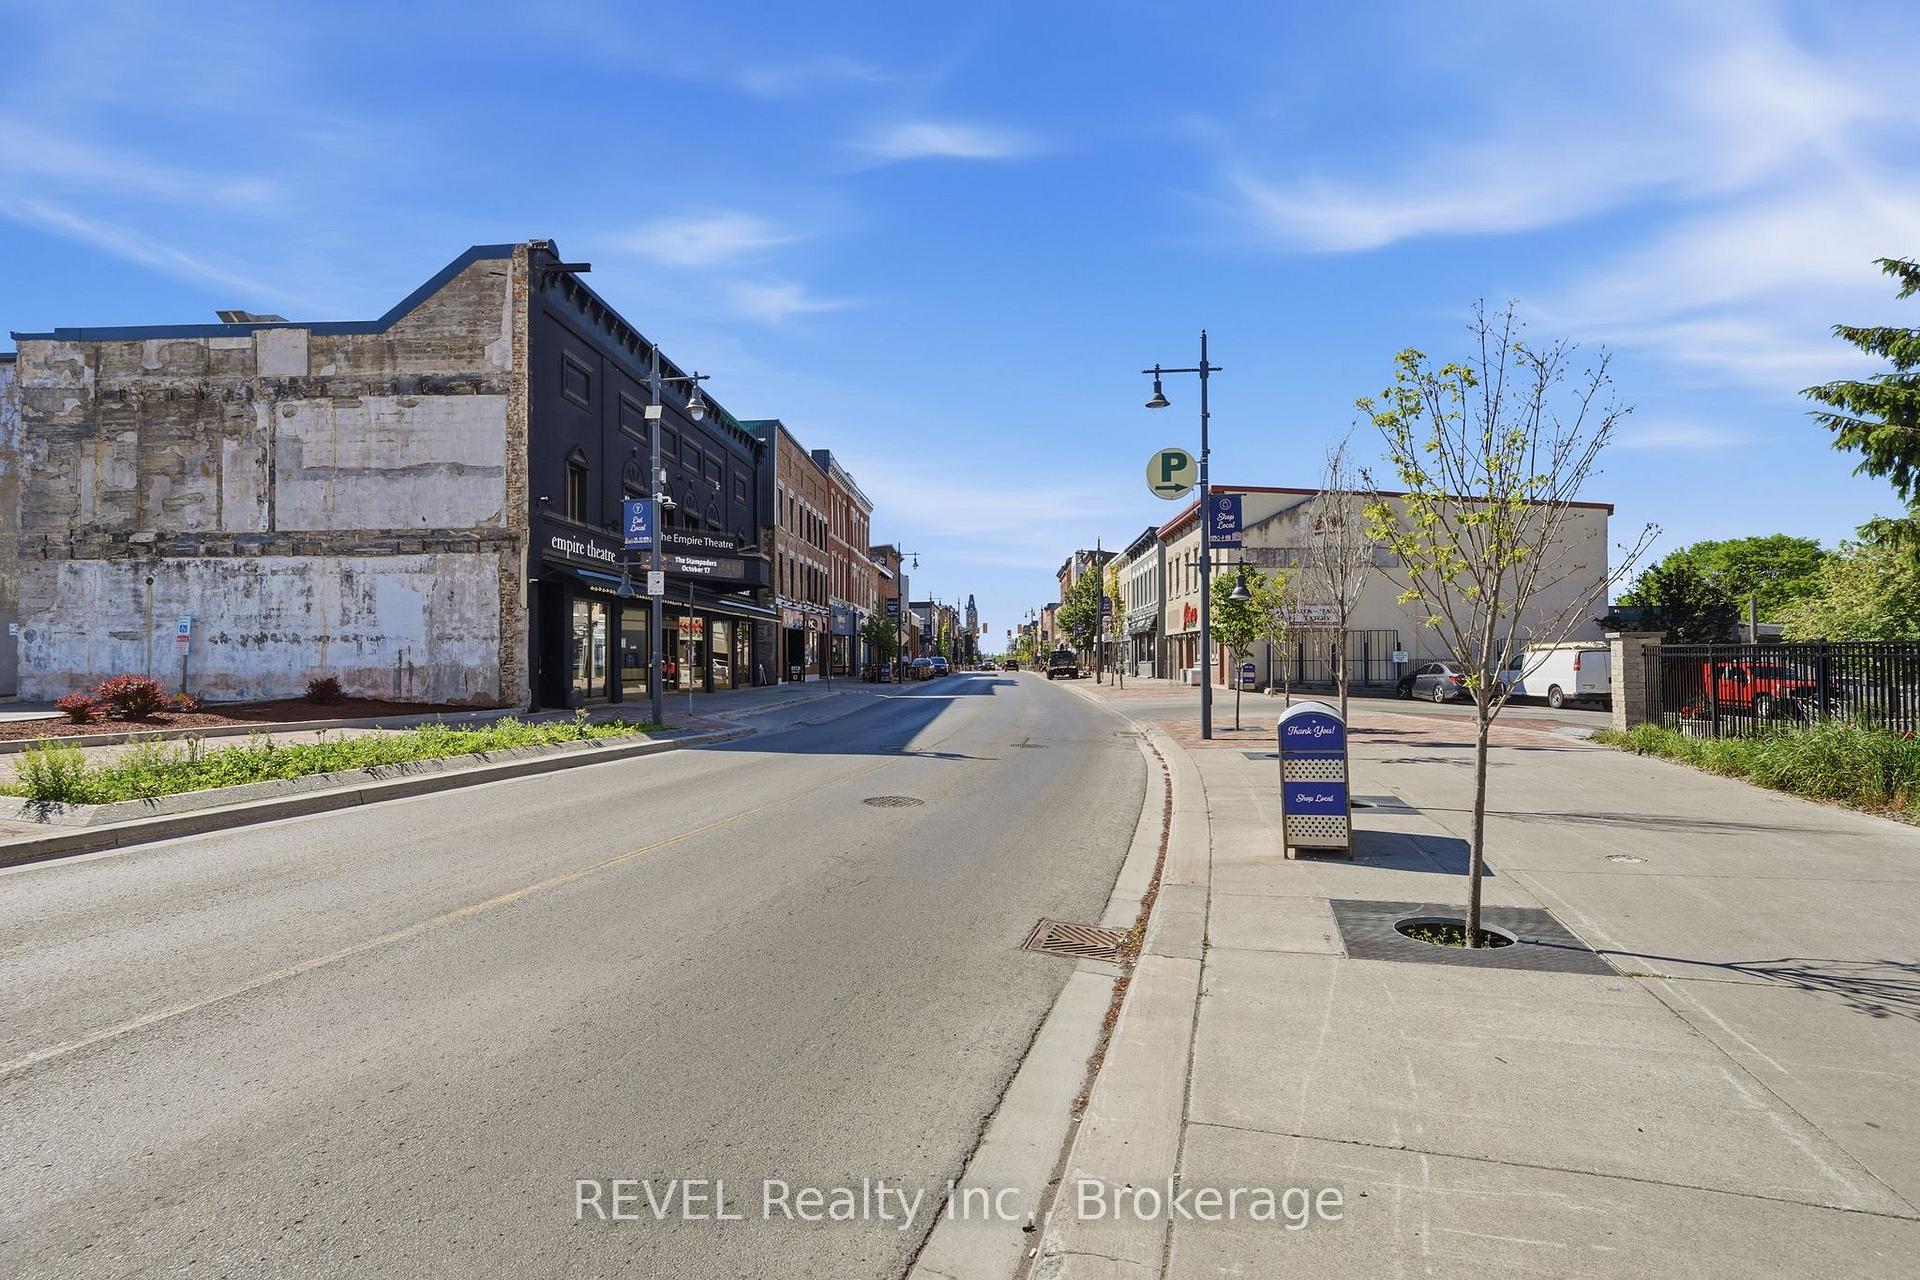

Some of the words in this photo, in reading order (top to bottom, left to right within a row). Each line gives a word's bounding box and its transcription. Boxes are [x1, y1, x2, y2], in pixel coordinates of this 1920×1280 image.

[1161, 452, 1188, 482] P
[1216, 512, 1235, 522] Shop
[1216, 521, 1235, 529] Local
[661, 532, 672, 542] he
[673, 533, 703, 546] Empire
[703, 537, 734, 549] Theatre
[551, 535, 585, 559] empire
[587, 539, 616, 563] theatre
[675, 556, 685, 564] The
[681, 565, 704, 573] October
[1287, 725, 1312, 736] Thank
[1313, 725, 1336, 738] You!
[1295, 793, 1314, 803] Shop
[1315, 793, 1334, 803] Local
